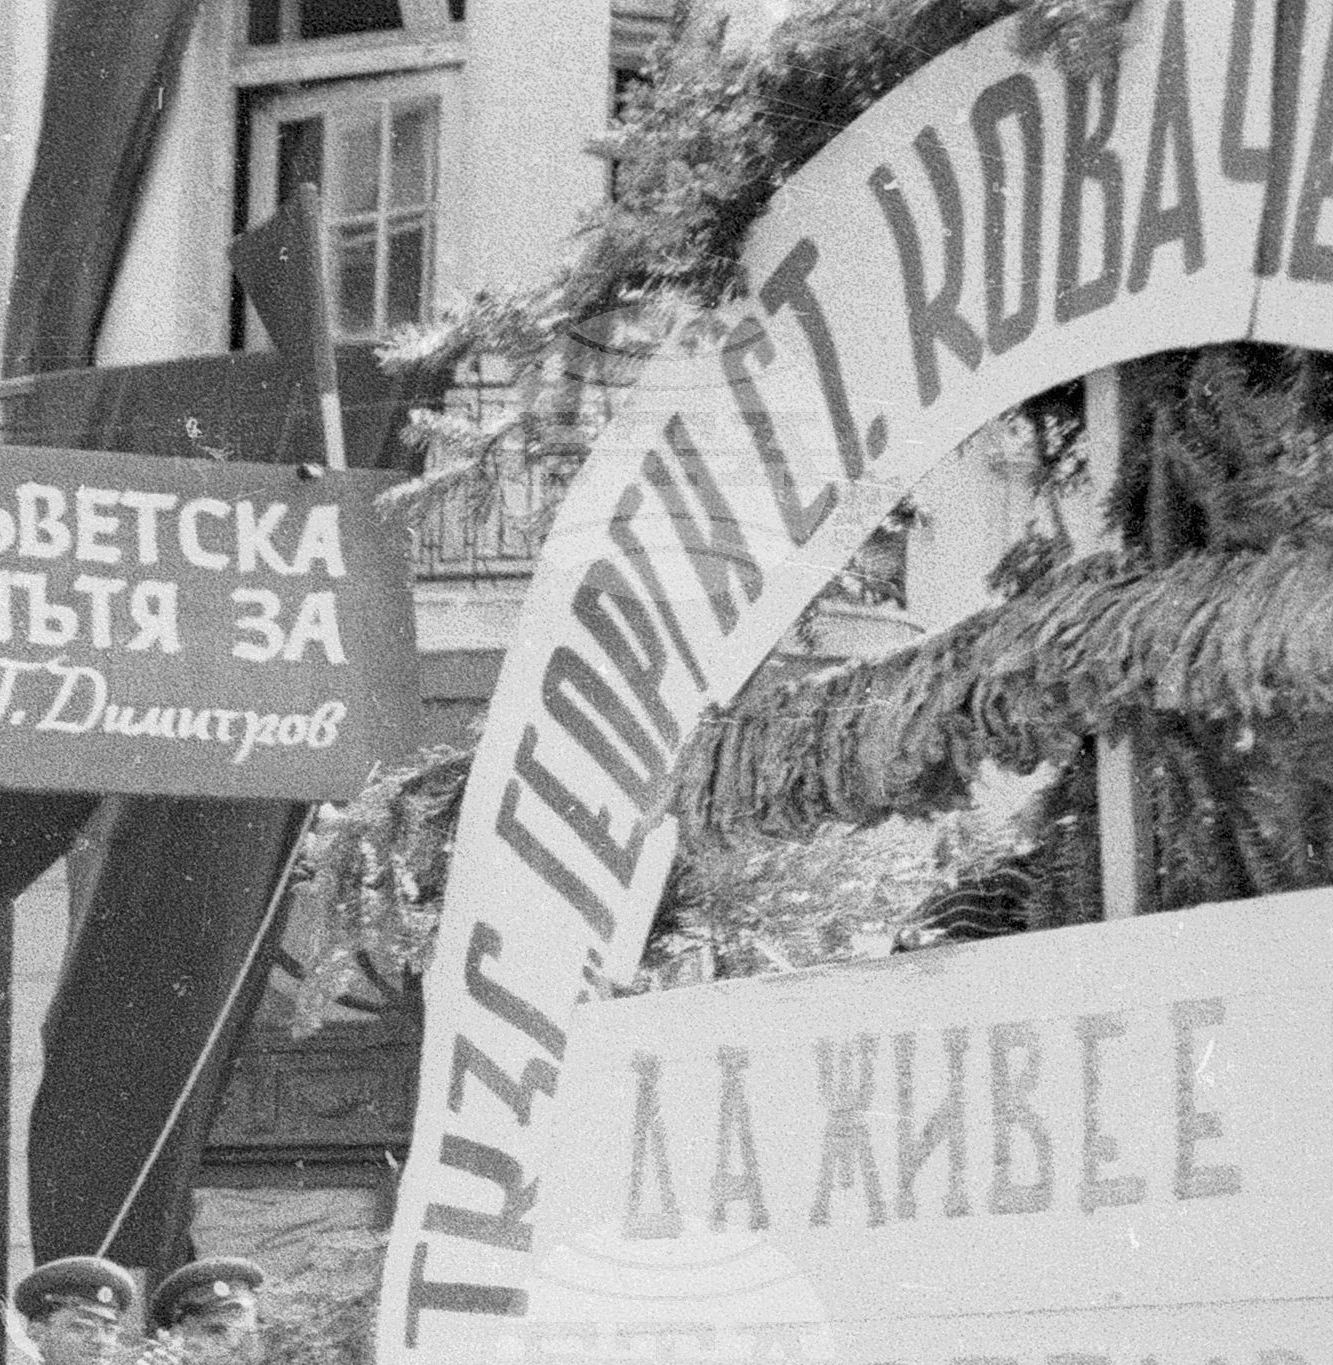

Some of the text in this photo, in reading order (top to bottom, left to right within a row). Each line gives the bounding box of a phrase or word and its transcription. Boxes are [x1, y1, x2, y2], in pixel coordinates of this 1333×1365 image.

[230, 586, 348, 664] ЗА
[620, 996, 1243, 1240] ДА ЖИВЕЕ
